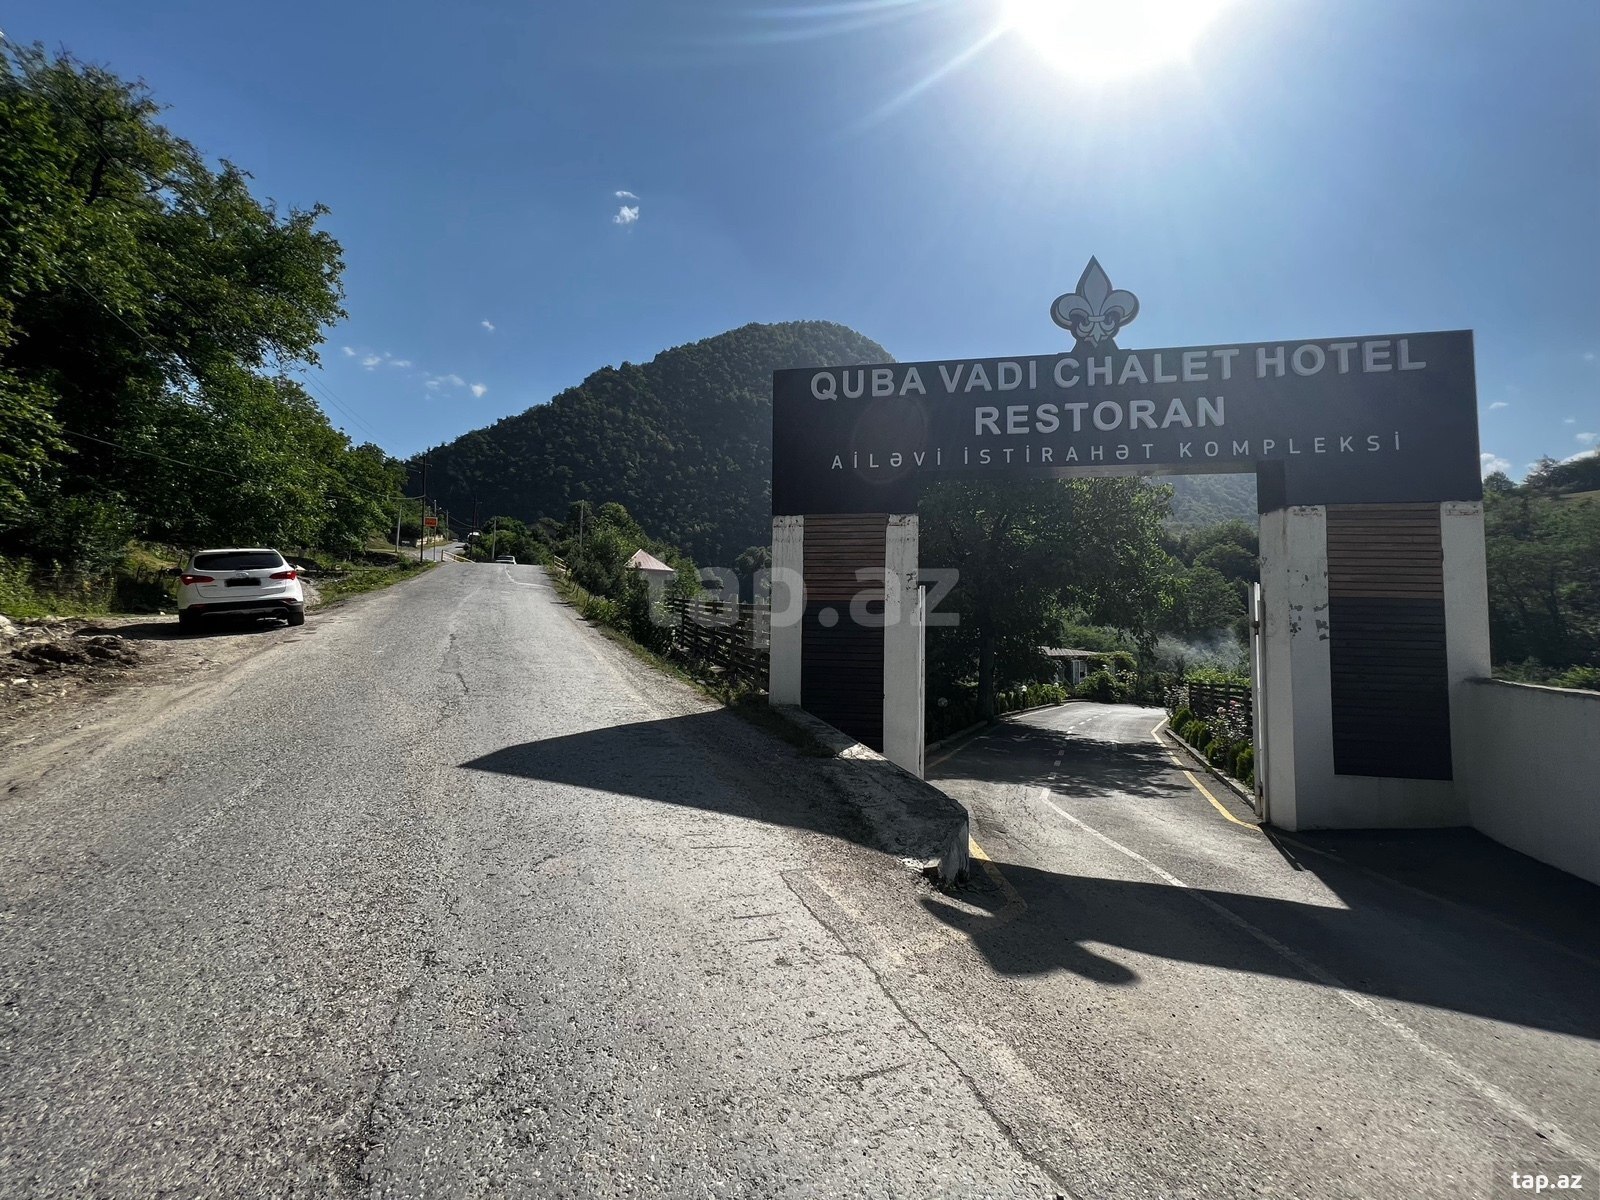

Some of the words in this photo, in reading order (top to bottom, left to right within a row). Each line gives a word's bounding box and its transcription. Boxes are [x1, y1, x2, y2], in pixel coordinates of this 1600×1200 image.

[811, 366, 927, 401] QUBA
[938, 359, 1037, 394] VADI
[1053, 348, 1240, 389] CHALET
[1255, 339, 1427, 379] HOTEL
[974, 396, 1226, 437] RESTORAN
[1179, 431, 1401, 459] KOMPLEKSİ
